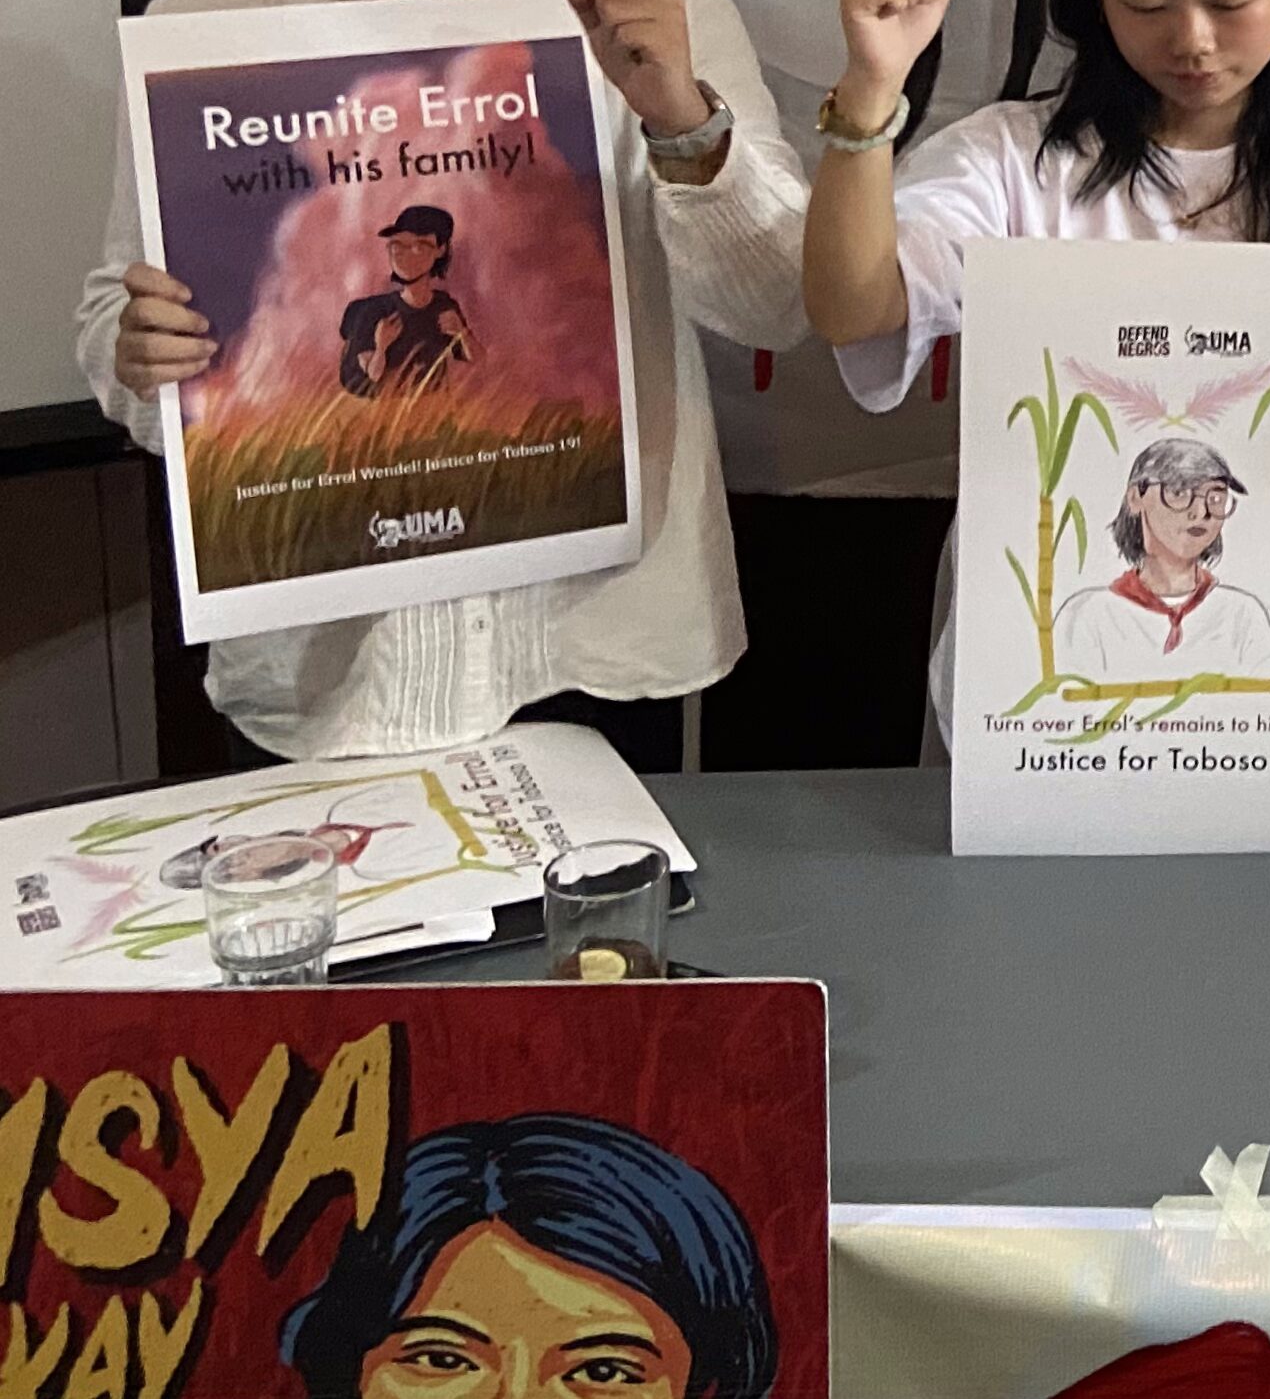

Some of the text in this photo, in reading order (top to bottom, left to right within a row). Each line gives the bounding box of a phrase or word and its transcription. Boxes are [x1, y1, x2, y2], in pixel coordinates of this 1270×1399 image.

[203, 73, 540, 150] Reunite Errol
[223, 132, 536, 197] with his family!
[1118, 325, 1169, 342] DEFEND
[1210, 331, 1252, 352] UMA
[1118, 341, 1170, 358] NEGROS
[236, 480, 288, 501] Justice
[291, 476, 315, 492] for
[318, 470, 357, 488] Errol
[425, 454, 474, 474] Justice
[477, 449, 500, 464] for
[501, 443, 556, 461] Toboso
[405, 505, 466, 536] UMA
[983, 714, 1025, 733] Turn
[1032, 719, 1073, 733] over
[1082, 715, 1144, 733] Errol's
[1151, 715, 1225, 734] remains
[1231, 716, 1249, 733] to
[1015, 747, 1107, 772] Justice
[1118, 745, 1158, 771] for
[1168, 746, 1268, 771] Toboso
